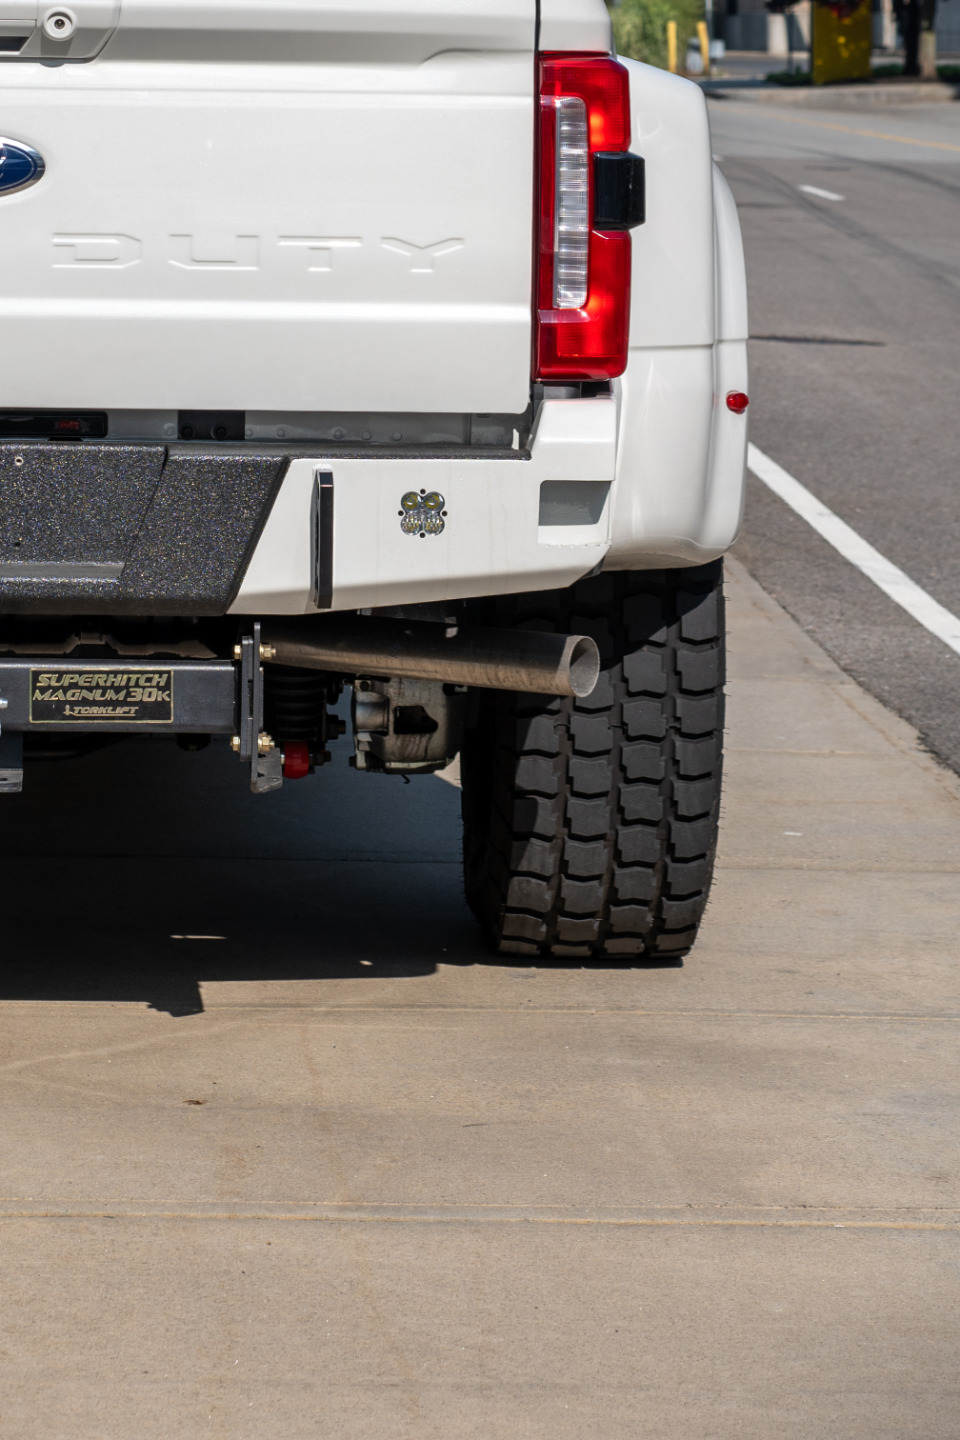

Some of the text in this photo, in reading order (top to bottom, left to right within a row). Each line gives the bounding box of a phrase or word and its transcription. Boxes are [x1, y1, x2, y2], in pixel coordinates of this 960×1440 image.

[51, 232, 465, 273] DUTY
[36, 673, 169, 687] SUPERHITCH
[32, 689, 127, 701] MAGNUM
[73, 706, 139, 715] TORKLIFT
